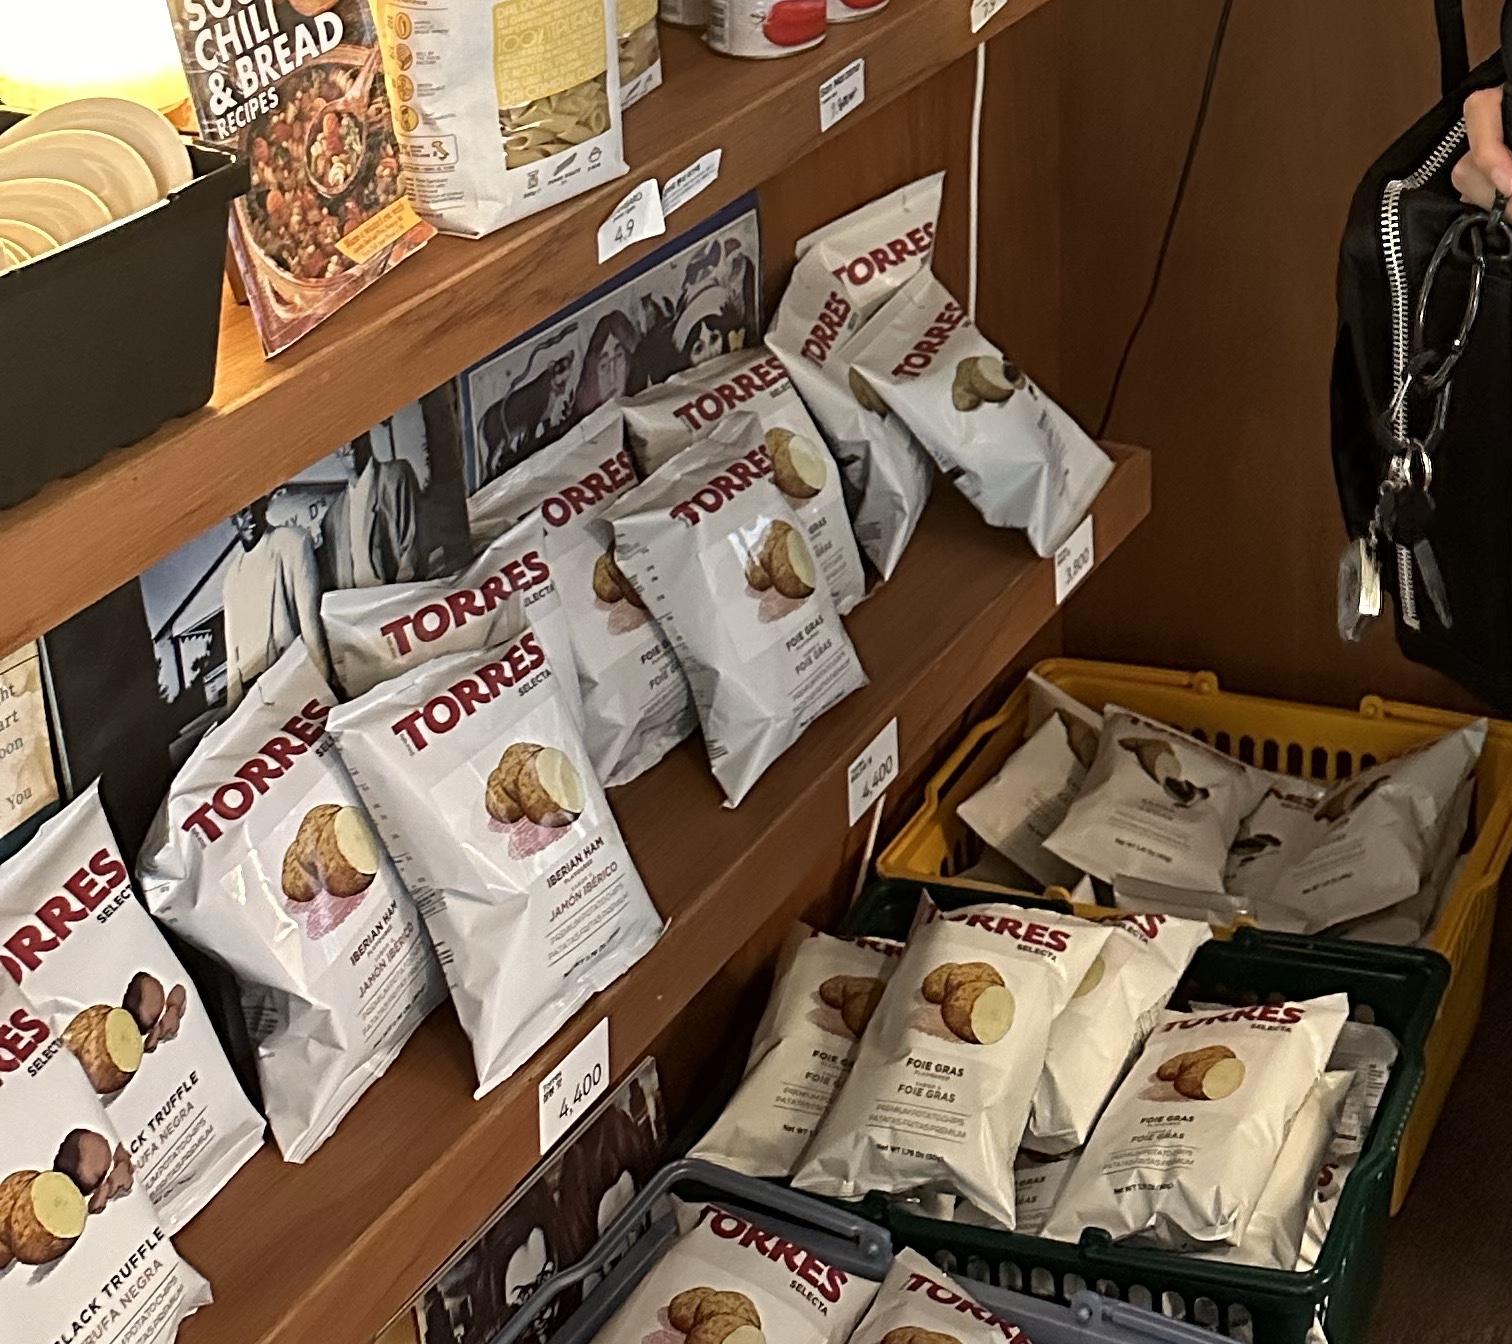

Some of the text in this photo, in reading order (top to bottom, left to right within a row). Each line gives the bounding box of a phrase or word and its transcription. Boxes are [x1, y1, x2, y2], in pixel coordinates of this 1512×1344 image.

[208, 11, 344, 116] & BREAD
[216, 86, 280, 140] RECIPES
[614, 218, 635, 242] 4.9
[673, 356, 791, 431] TORRES
[541, 450, 635, 528] ORRES
[380, 550, 550, 656] TORRES
[640, 642, 661, 664] FOIE
[785, 629, 805, 651] FOIE
[391, 632, 545, 752] TORRES
[518, 668, 552, 697] SELECTA
[181, 698, 331, 843] TORRES
[862, 755, 893, 798] 4,400
[6, 787, 32, 810] You
[546, 835, 605, 889] IBERIAN HAM
[549, 889, 583, 923] JAMÓN
[350, 898, 398, 966] IBERIAN HAM
[1017, 944, 1058, 963] SELECTA
[812, 1049, 838, 1063] FOIE
[906, 1057, 964, 1078] FOIE GRAS
[147, 1070, 199, 1133] TRUFFLE
[559, 1063, 602, 1119] 4,400
[897, 1084, 956, 1103] FOIE GRAS
[159, 1101, 195, 1144] NEGRA
[101, 1226, 165, 1298] TRUFFLE
[120, 1259, 164, 1311] NEGRA
[789, 1279, 828, 1316] SELECTA
